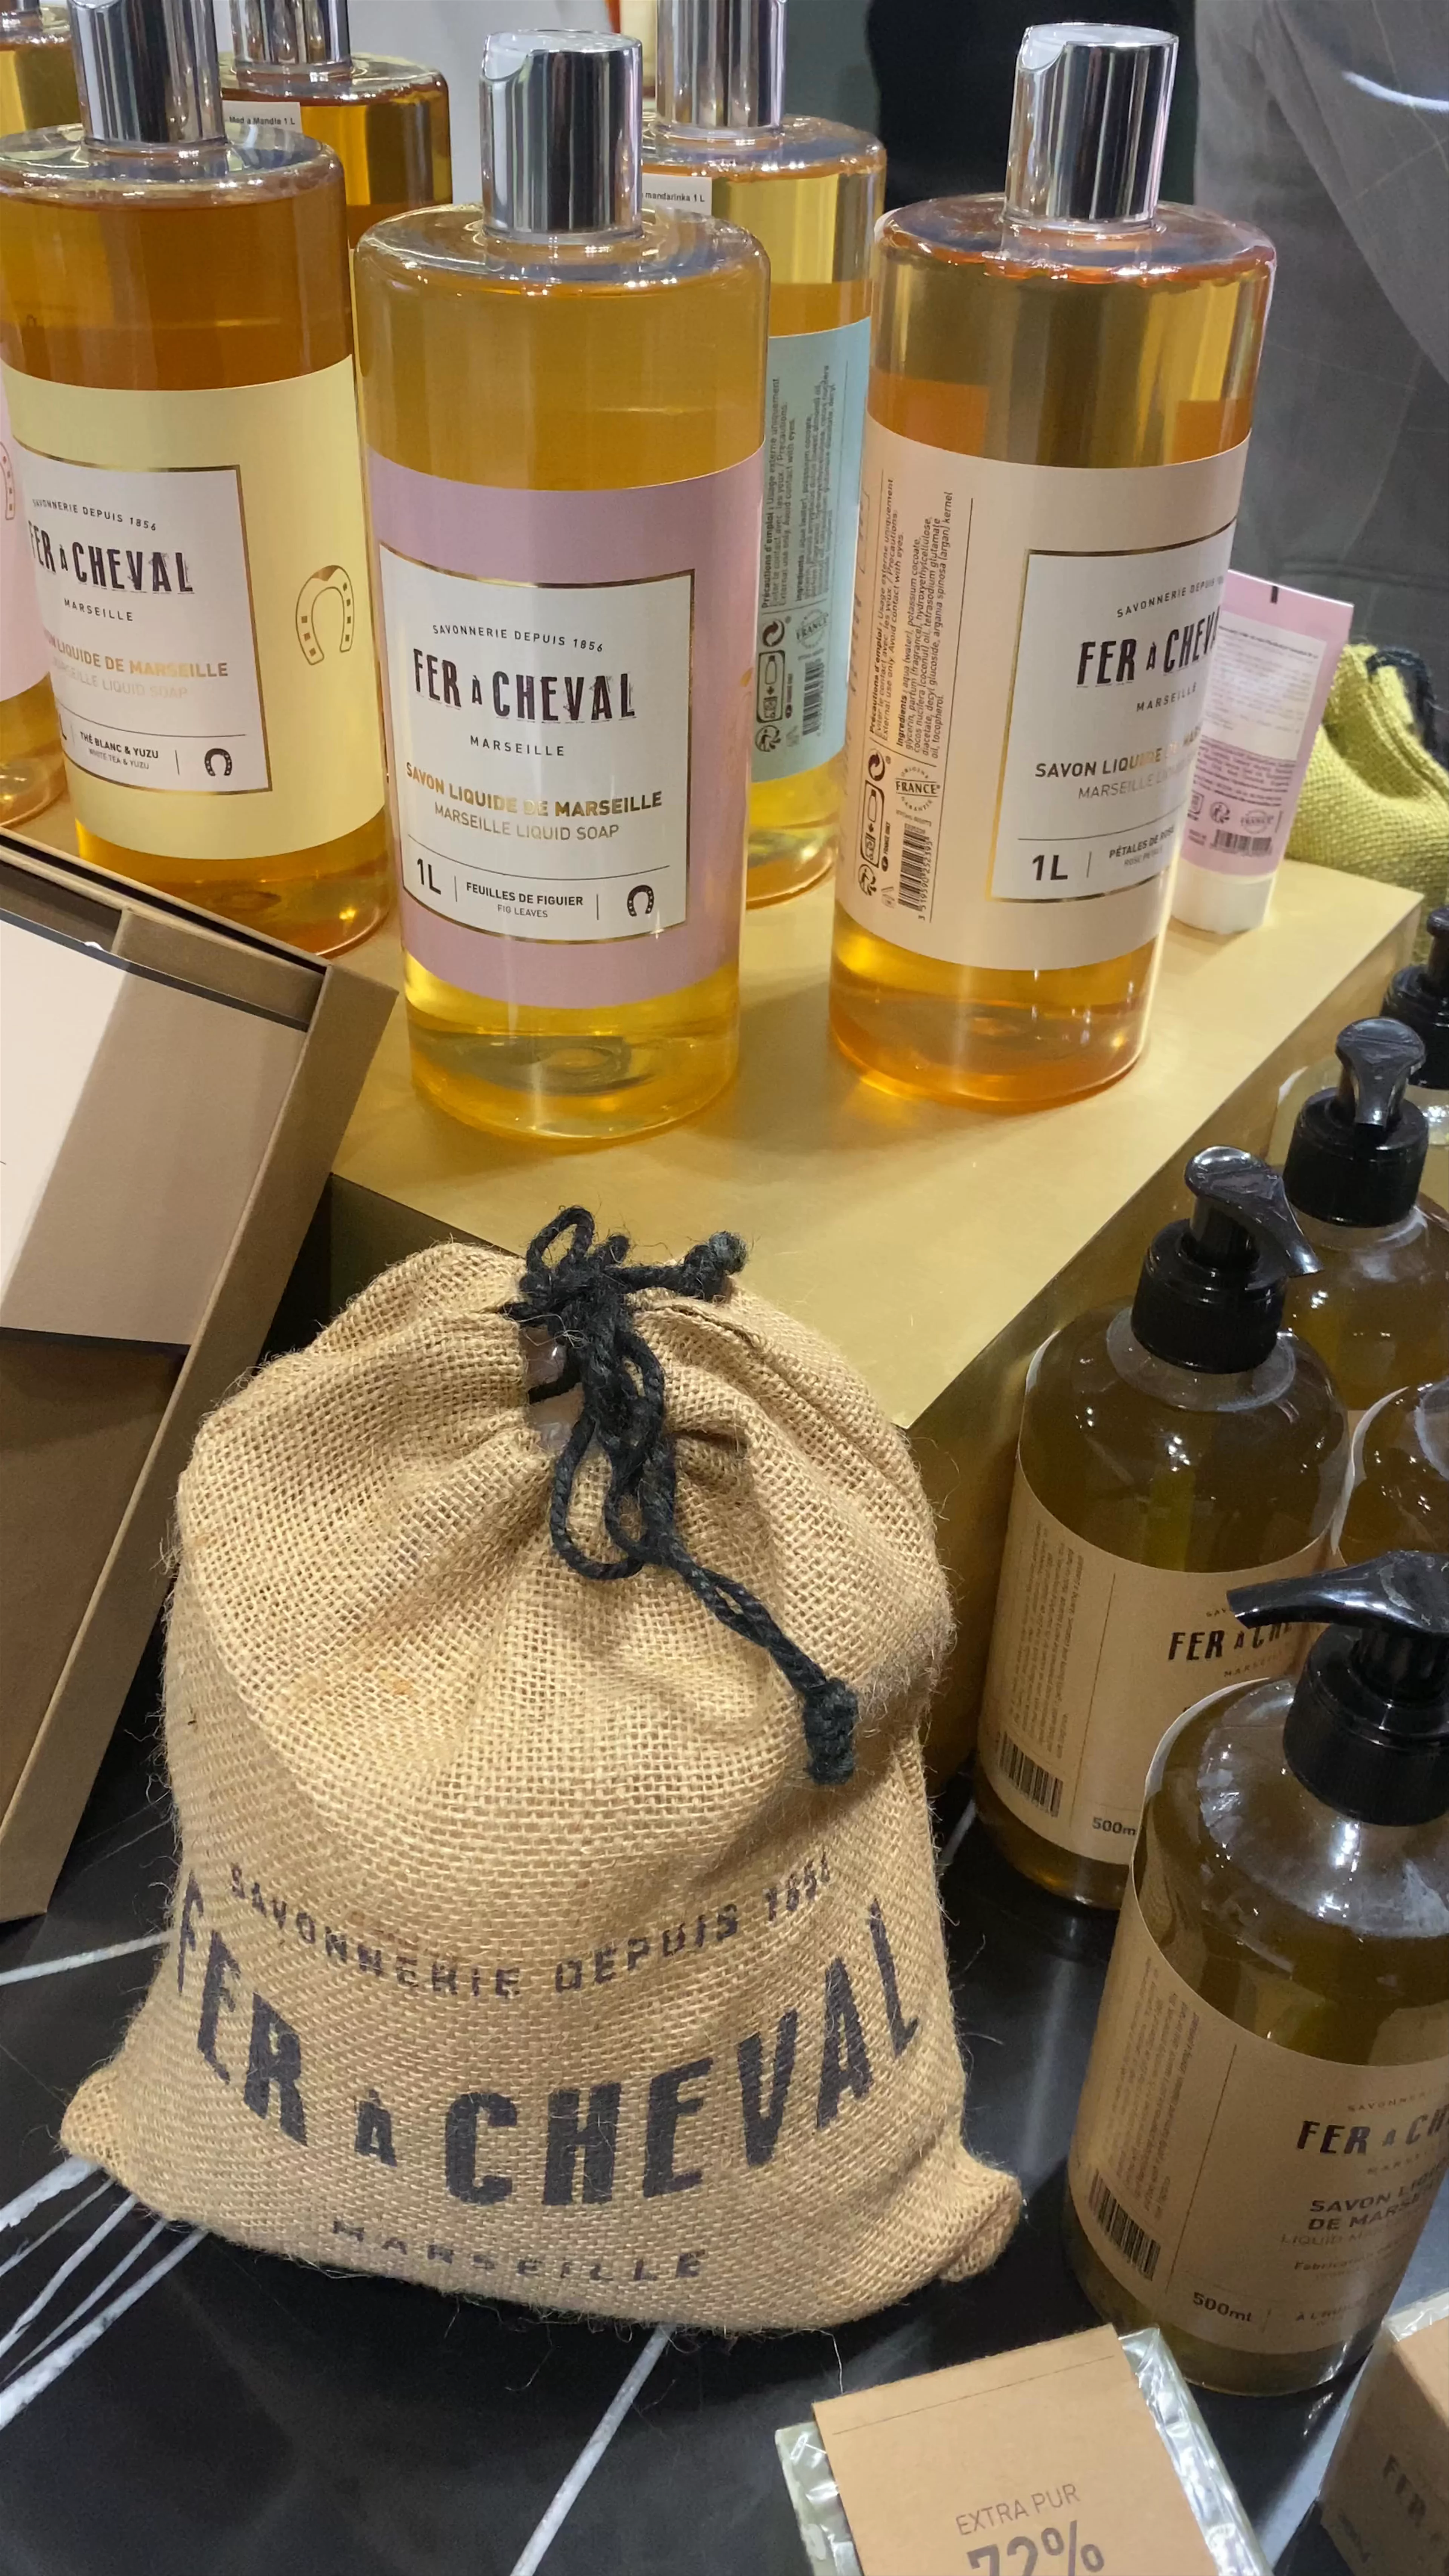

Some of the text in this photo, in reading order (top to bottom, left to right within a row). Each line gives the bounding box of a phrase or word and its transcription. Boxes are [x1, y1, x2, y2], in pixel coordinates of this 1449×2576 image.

[32, 498, 157, 531] SAVONNERIE DEPUIS 1856
[942, 491, 953, 524] kernel
[28, 520, 194, 594] FER À CHEVAL
[929, 518, 941, 568] glutamate
[893, 561, 901, 583] with
[936, 563, 947, 600] spinosa
[64, 598, 134, 621] MARSEILLE
[891, 585, 900, 623] contact
[923, 570, 936, 627] tetrasodium
[1117, 586, 1186, 618] SAVONNERIE
[933, 601, 943, 638] argania
[432, 624, 604, 652] SAVONNERIE DEPUIS 1856
[888, 625, 897, 654] Avoid
[1077, 638, 1137, 687] FER
[1146, 641, 1157, 670] À
[1163, 606, 1220, 674] CHEV
[57, 638, 229, 678] LIQUIDE DE MARSEILLE
[896, 695, 907, 747] Ingredients
[906, 578, 917, 627] potassium
[928, 640, 941, 686] glucoside,
[413, 647, 637, 723] FER À CHEVAL
[908, 678, 917, 711] parfum
[926, 687, 935, 712] decyl
[1136, 681, 1197, 712] MARSEILLE
[915, 689, 925, 726] nucifera
[80, 731, 159, 759] THÉ BLANC & YUZU
[470, 735, 565, 757] MARSEILLE
[108, 755, 121, 764] TEA
[129, 760, 149, 770] YUZU
[1035, 761, 1097, 778] SAVON
[406, 762, 663, 817] SAVON LIQUIDE DE MARSEILLE
[1078, 773, 1153, 799] MARSEILLE
[435, 801, 619, 841] MARSEILLE LIQUID SOAP
[1109, 840, 1148, 858] PÉTALES
[1149, 834, 1159, 847] DE
[416, 858, 442, 895] 1L
[1032, 854, 1068, 881] 1L
[466, 881, 583, 906] FEUILLES DE FIGUIER
[497, 904, 548, 918] FIG LEAVES
[1168, 1630, 1225, 1661] FER
[1092, 1816, 1137, 1836] 500m
[230, 1862, 521, 2000] SAVONNERIE
[555, 1903, 739, 1994] DEPUIS
[177, 1868, 309, 2148] FER
[444, 1897, 919, 2207] CHEVAL
[1297, 2120, 1371, 2155] FER
[1310, 2192, 1391, 2213] SAVON
[1308, 2218, 1342, 2231] DE
[332, 2219, 709, 2282] MARSEILLE
[955, 2483, 1082, 2536] EXTRA PUR
[966, 2519, 1104, 2576] 72%
